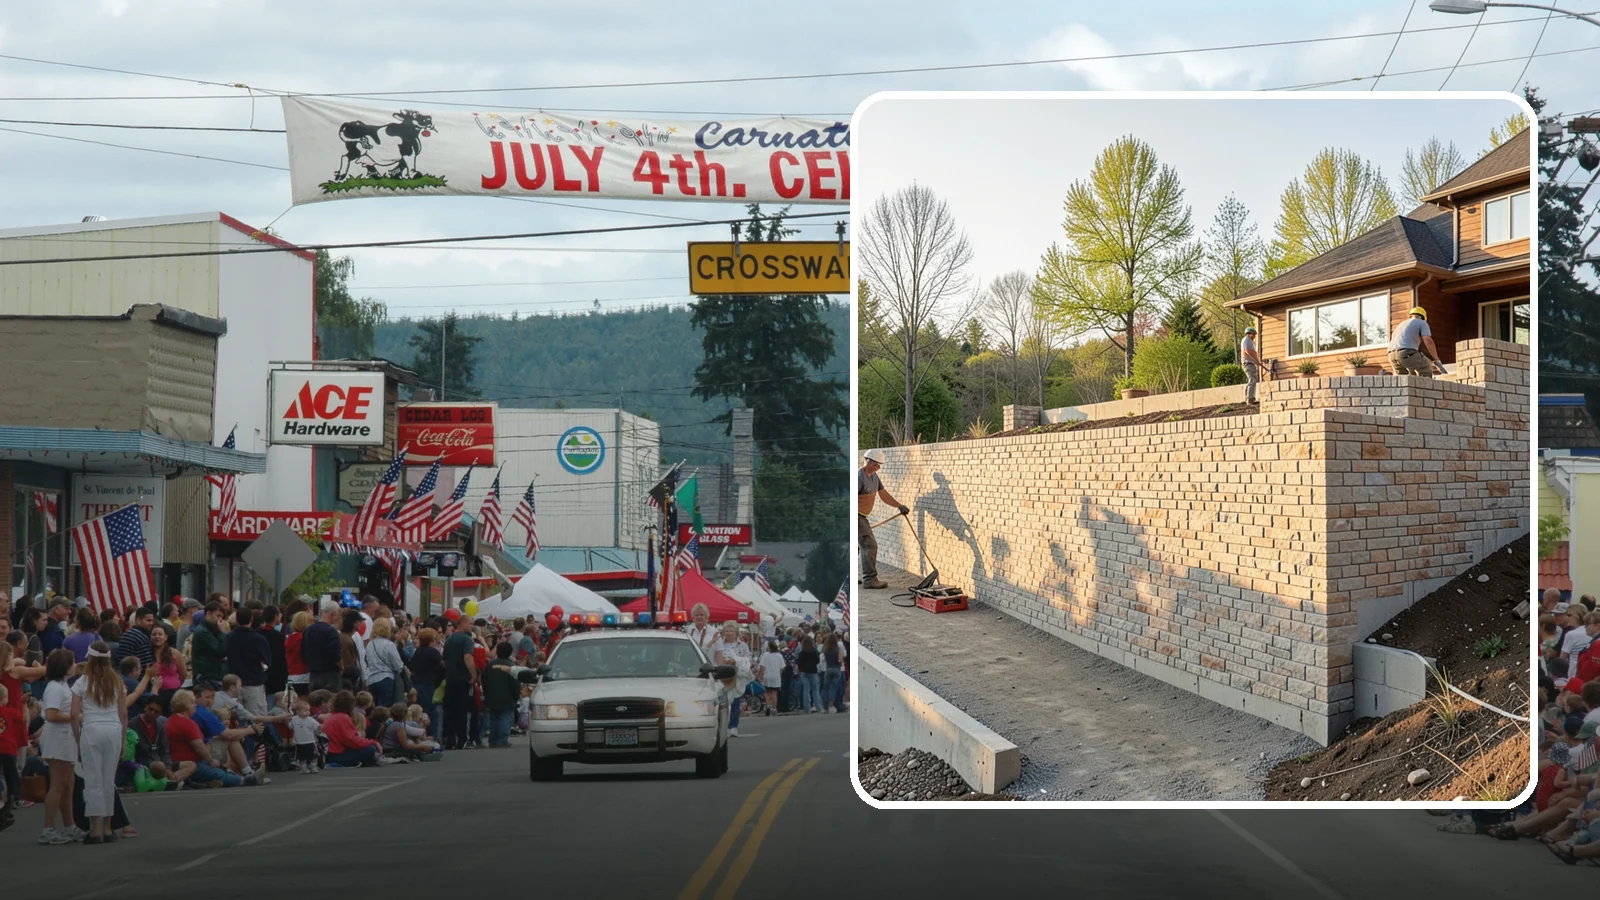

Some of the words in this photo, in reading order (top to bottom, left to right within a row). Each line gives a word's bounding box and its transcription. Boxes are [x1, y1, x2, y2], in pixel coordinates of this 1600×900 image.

[481, 141, 605, 193] JULY
[632, 150, 746, 198] 4th.
[697, 254, 850, 280] CROSSWA
[282, 380, 374, 420] ACE
[405, 409, 452, 422] CEDAR
[461, 409, 485, 421] LOG
[283, 421, 371, 437] Hardware
[416, 428, 477, 447] Coca-Cola
[353, 467, 385, 481] Simpl
[83, 485, 93, 495] St.
[96, 485, 124, 495] Vincent
[126, 486, 136, 495] de
[138, 486, 155, 495] Paul
[81, 503, 154, 522] THT
[688, 527, 741, 535] CRNATION
[699, 535, 730, 543] GLASS
